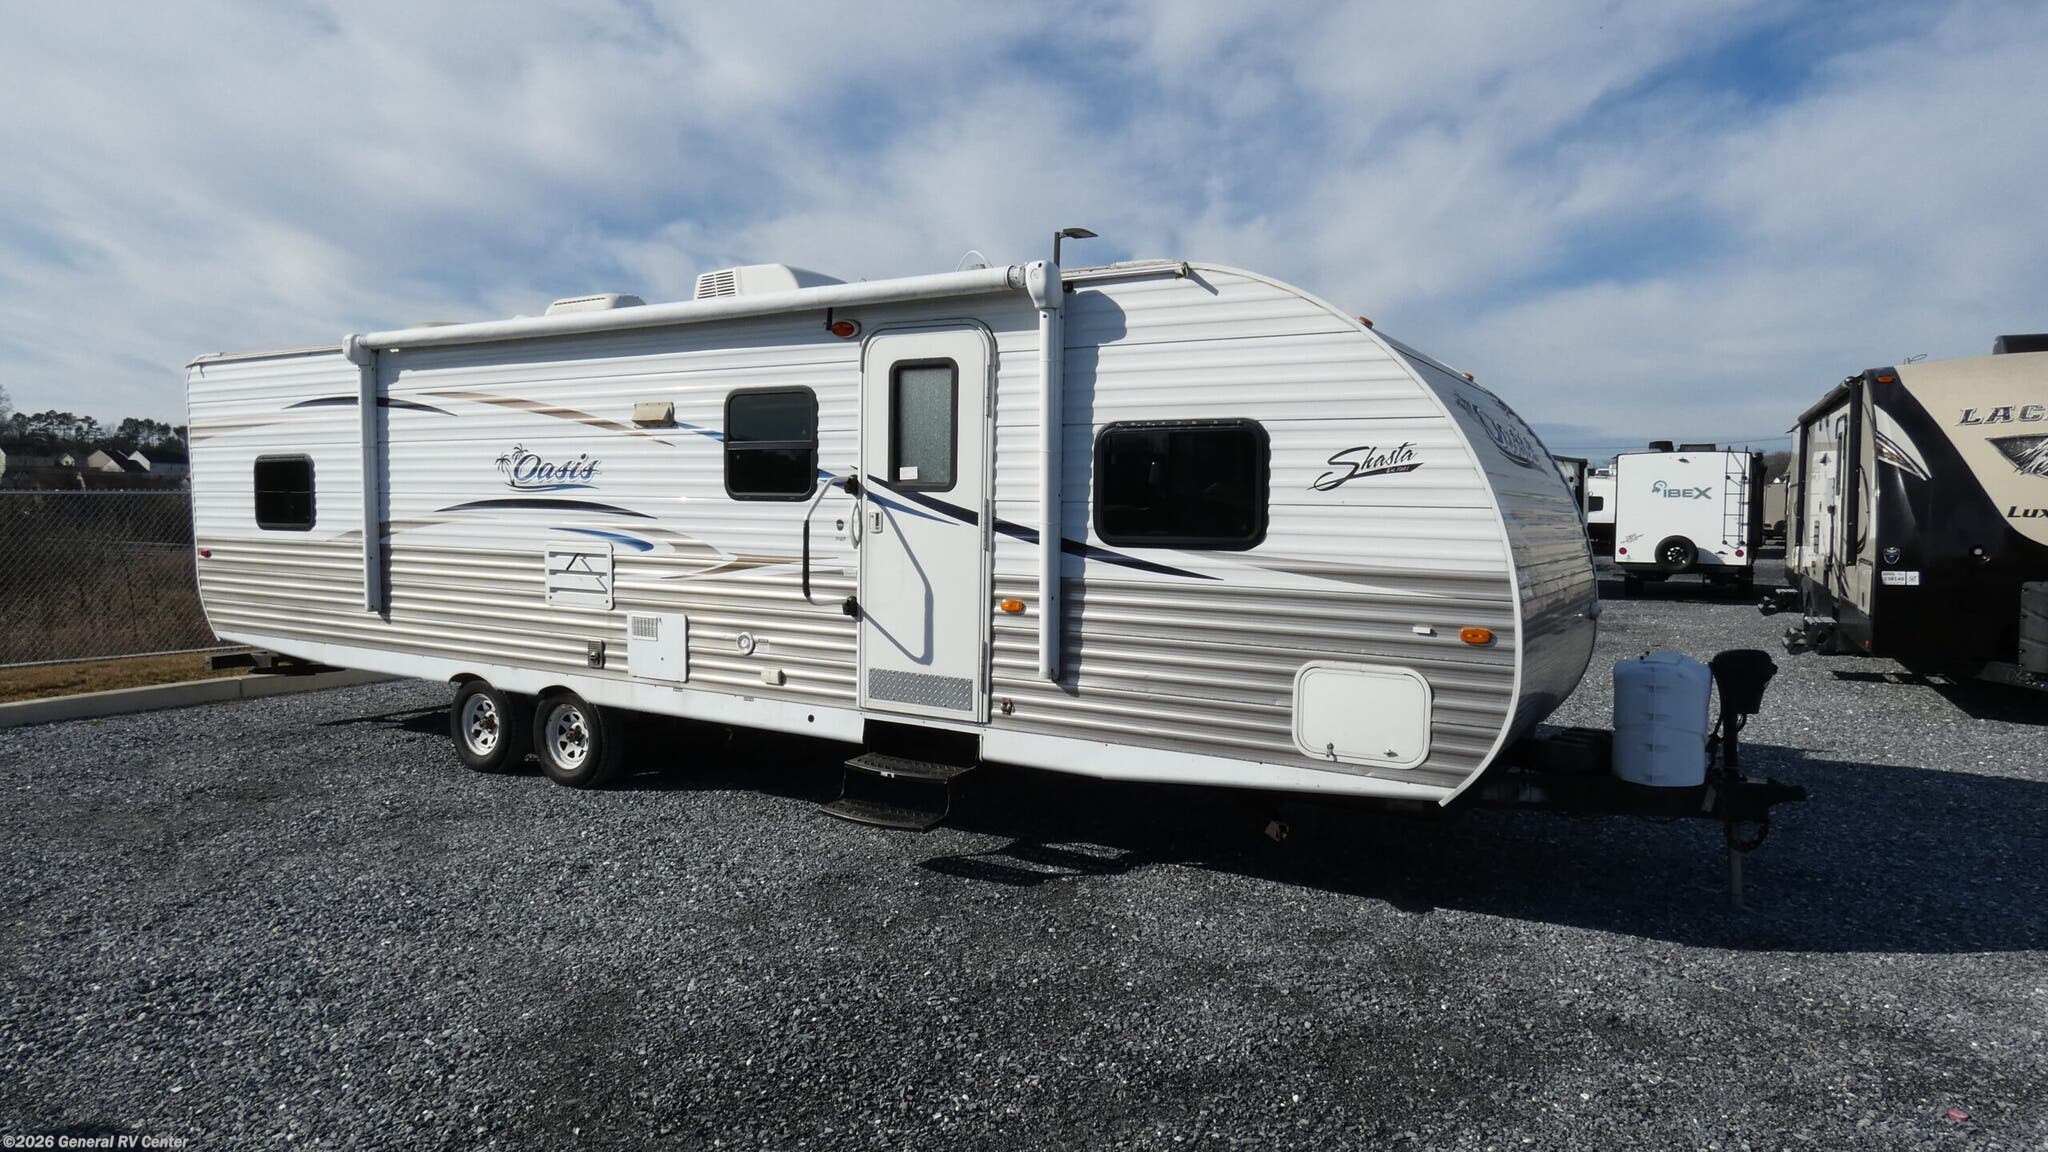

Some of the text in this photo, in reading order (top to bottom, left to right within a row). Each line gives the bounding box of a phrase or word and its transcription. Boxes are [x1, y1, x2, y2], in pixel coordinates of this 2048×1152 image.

[1958, 405, 2048, 426] LAC
[513, 453, 602, 482] Oasis
[1306, 441, 1420, 492] Shasta
